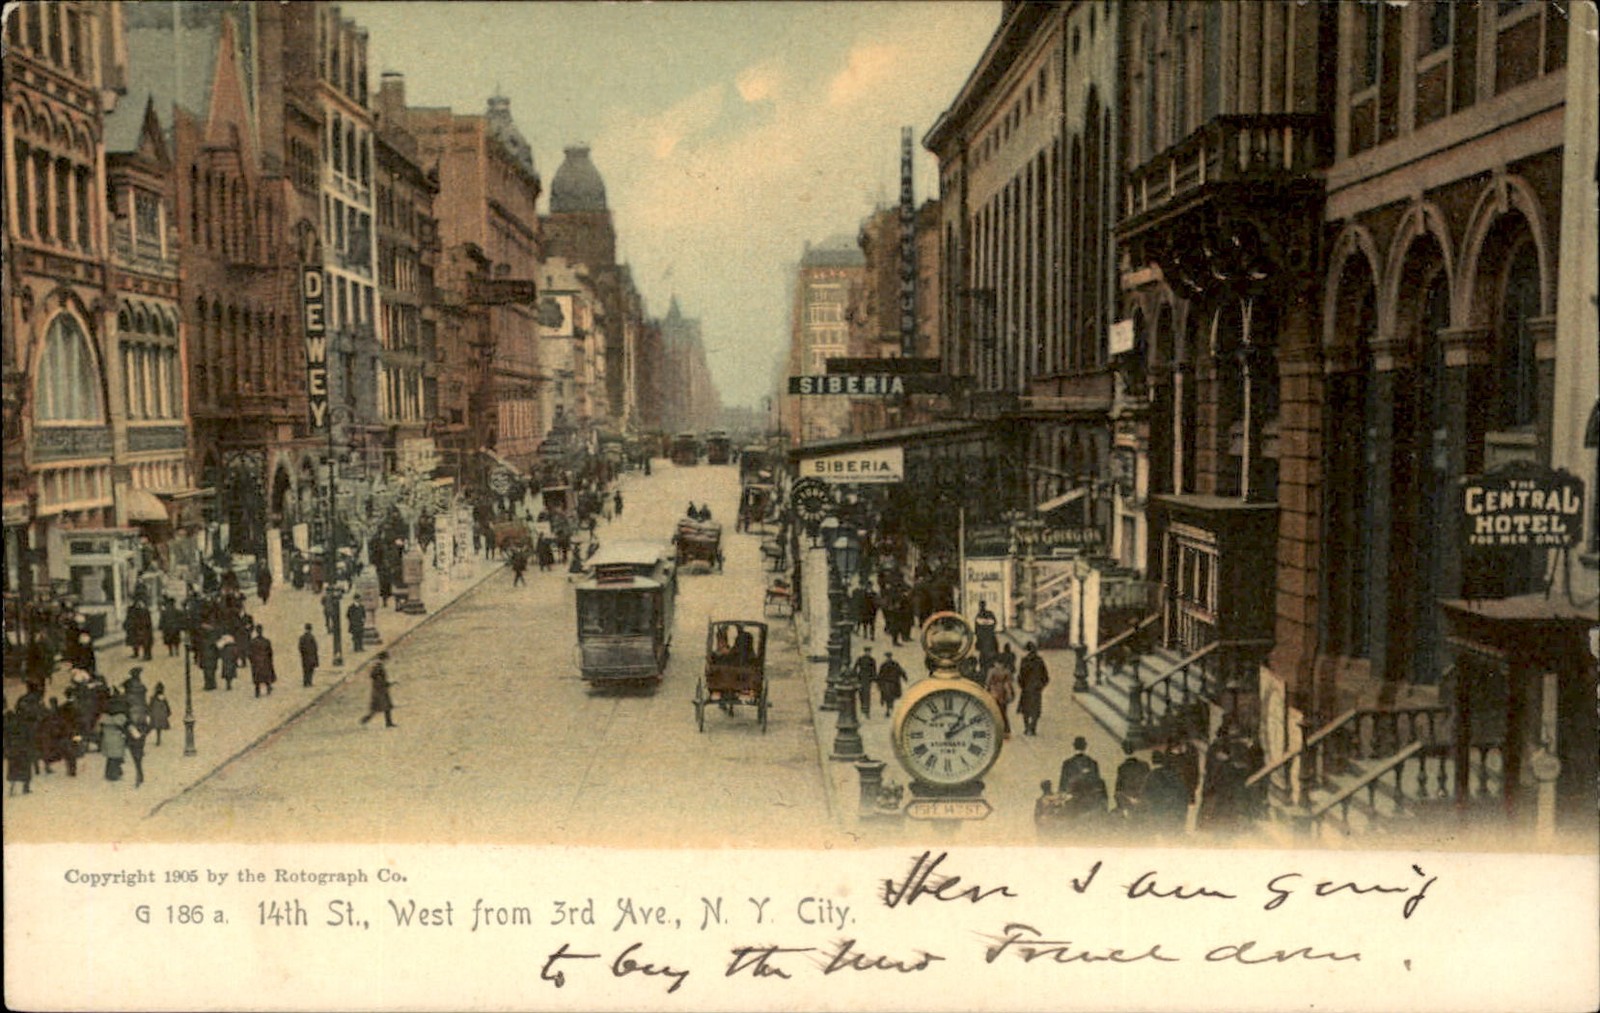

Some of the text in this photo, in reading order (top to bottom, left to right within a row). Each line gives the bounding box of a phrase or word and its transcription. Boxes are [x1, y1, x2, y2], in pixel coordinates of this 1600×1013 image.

[305, 271, 327, 428] DEWEY
[799, 376, 904, 394] SIBERIA
[815, 460, 890, 474] SIBERIA
[1509, 480, 1536, 489] THE
[1465, 486, 1580, 515] CENTRAL
[1475, 515, 1567, 534] HOTEL
[1072, 861, 1103, 893] I
[1128, 871, 1237, 899] am
[541, 943, 601, 988] to
[612, 943, 690, 993] buy
